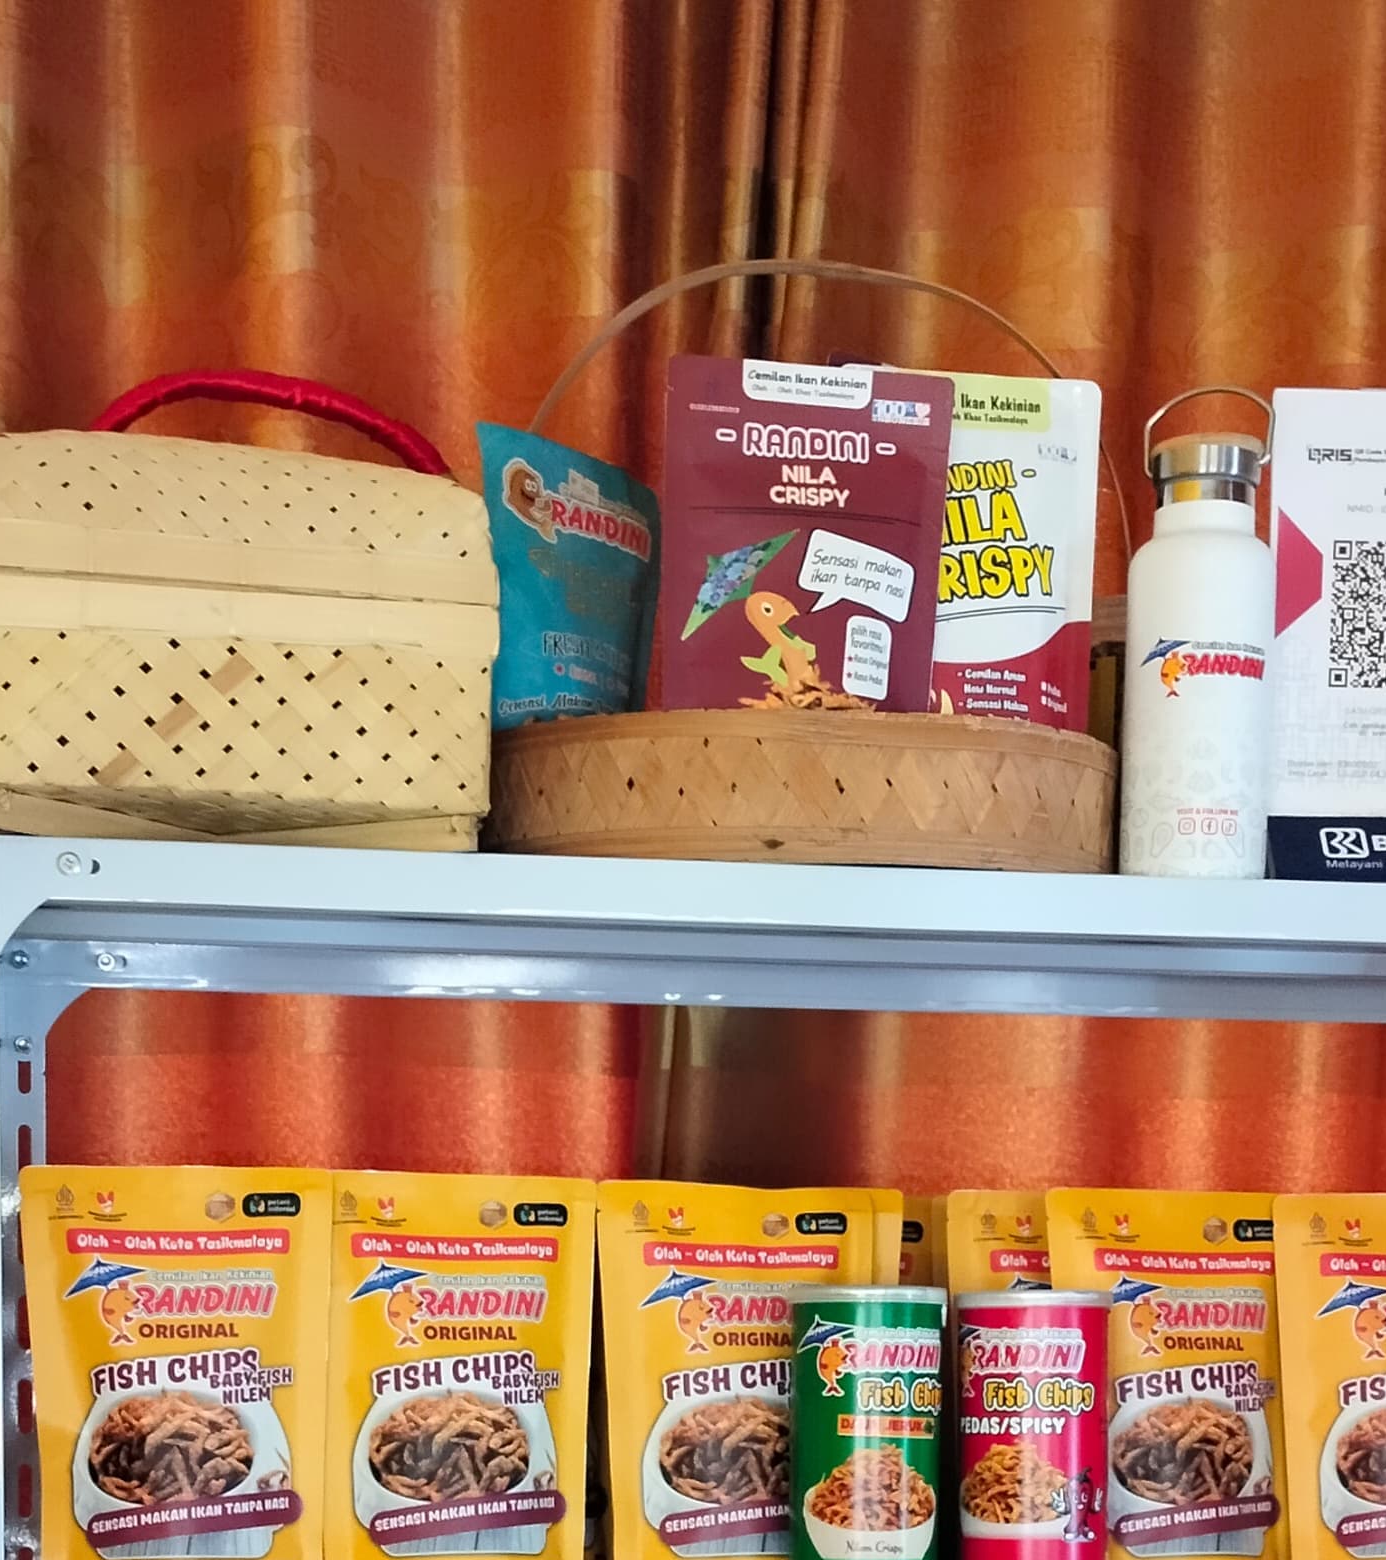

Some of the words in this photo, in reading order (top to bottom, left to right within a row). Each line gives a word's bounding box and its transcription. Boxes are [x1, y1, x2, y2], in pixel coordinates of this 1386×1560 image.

[748, 369, 792, 384] Cemilan
[795, 373, 818, 385] Ikan
[820, 376, 867, 390] Kekinian
[961, 393, 985, 409] Ikan
[990, 396, 1041, 413] Kekinian
[964, 414, 981, 423] Khas
[742, 422, 870, 464] RANDINI
[1308, 448, 1352, 464] QRIS
[782, 465, 836, 485] NILA
[946, 459, 1017, 492] NDINI
[770, 486, 850, 508] CRISPY
[551, 498, 650, 560] RANDINI
[811, 549, 858, 568] Sensasi
[865, 560, 902, 579] makan
[938, 544, 1054, 603] RISPY
[810, 568, 837, 584] ikan
[844, 574, 881, 593] tanpa
[885, 585, 905, 599] nasi
[965, 668, 1001, 680] Cemilan
[1183, 653, 1265, 680] RANDINI
[1326, 860, 1382, 870] Melayani
[76, 1234, 109, 1250] Oleh
[125, 1234, 156, 1251] Oleh
[159, 1234, 194, 1251] Kota
[197, 1235, 283, 1252] Tasikmalaya
[136, 1283, 279, 1319] RANDINI
[419, 1287, 548, 1323] RANDINI
[1157, 1301, 1266, 1333] RANDINI
[138, 1322, 239, 1341] ORIGINAL
[422, 1324, 517, 1342] ORIGINAL
[1164, 1335, 1243, 1352] ORIGINAL
[974, 1338, 1084, 1374] RANDINI
[92, 1360, 159, 1392] FISH
[166, 1348, 259, 1384] CHIPS
[209, 1370, 255, 1390] BABY
[258, 1367, 293, 1386] FISH
[372, 1363, 442, 1396] FISH
[451, 1351, 534, 1390] CHIPS
[222, 1387, 271, 1405] NILEM
[859, 1378, 907, 1412] Fish
[982, 1381, 1032, 1412] Fish
[1035, 1380, 1094, 1413] Chips
[960, 1415, 1067, 1436] PEDAS/SPICY
[92, 1515, 138, 1534] SENSASI
[140, 1508, 188, 1528] MAKAN
[190, 1505, 223, 1523] IKAN
[226, 1500, 262, 1517] TANPA
[264, 1497, 290, 1512] NASI
